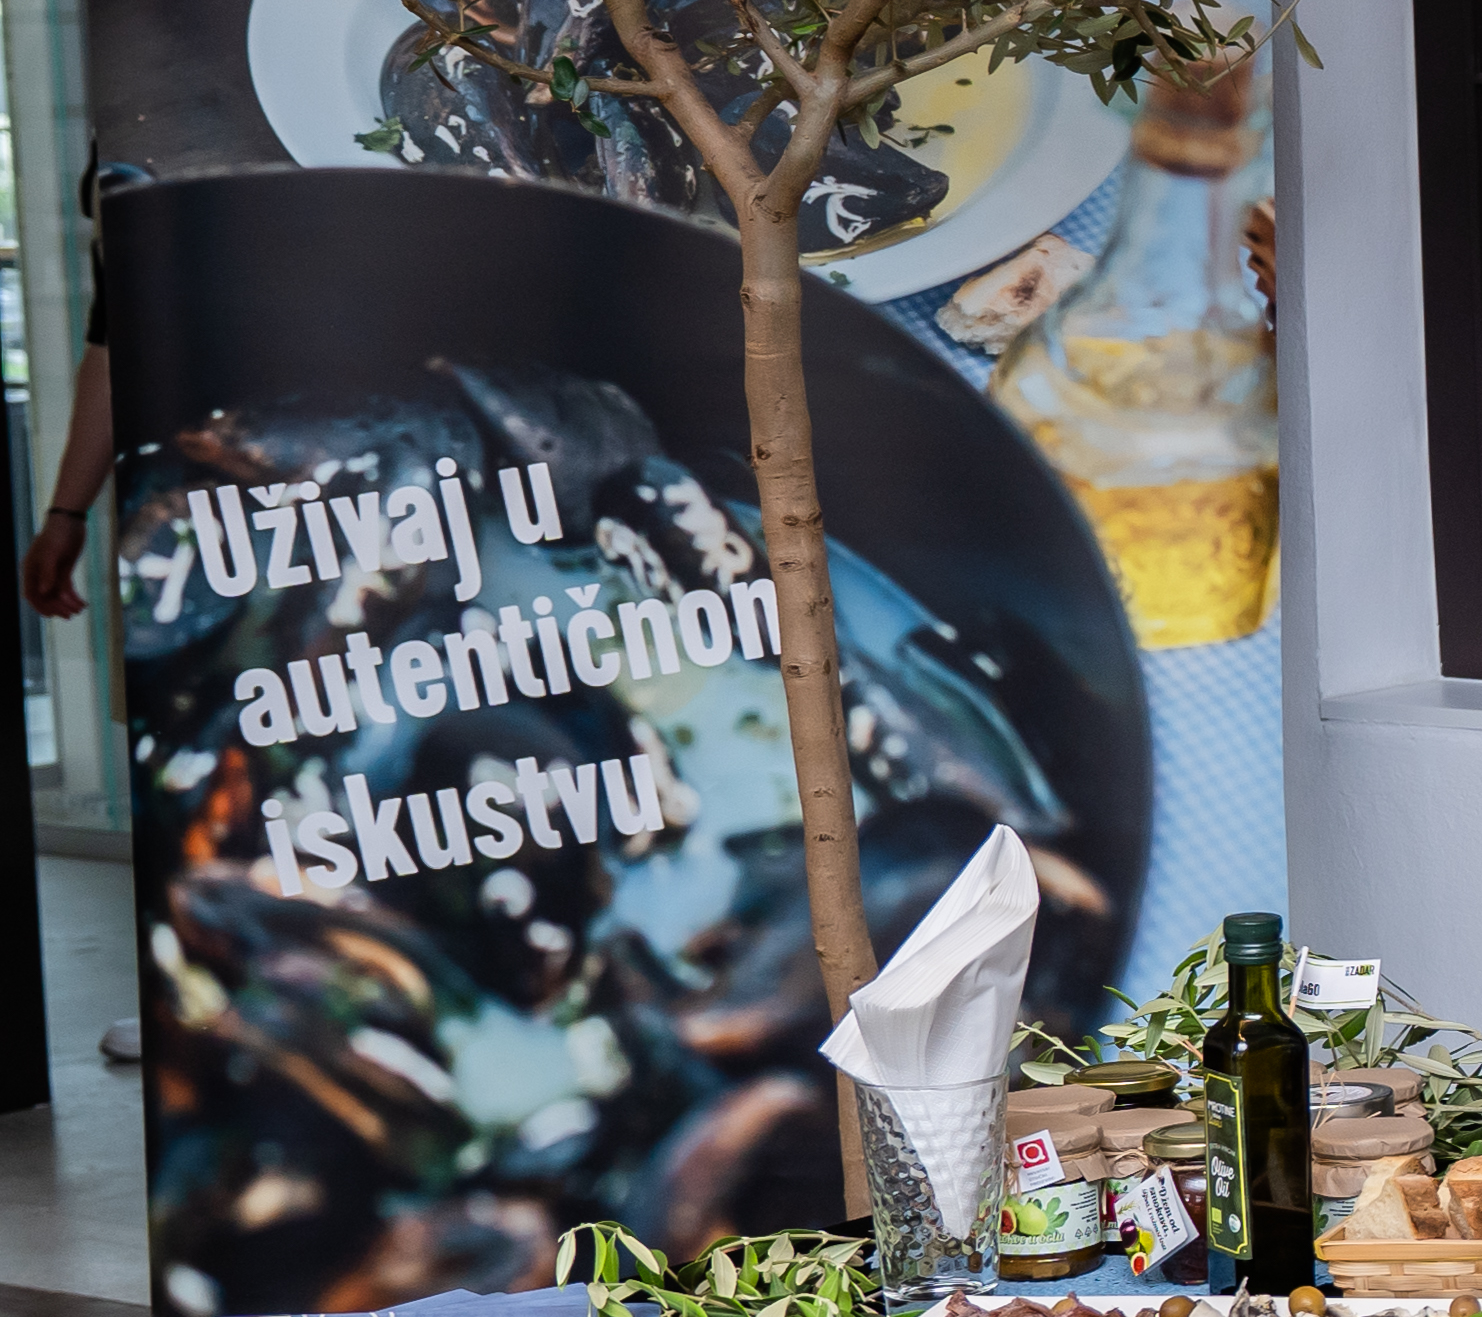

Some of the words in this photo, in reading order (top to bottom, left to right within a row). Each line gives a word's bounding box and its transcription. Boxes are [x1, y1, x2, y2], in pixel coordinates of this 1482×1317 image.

[187, 458, 482, 602] Uživaj
[499, 462, 563, 544] u
[261, 753, 664, 898] iskustvu
[1211, 1156, 1235, 1180] Olive
[1215, 1177, 1231, 1198] Oil
